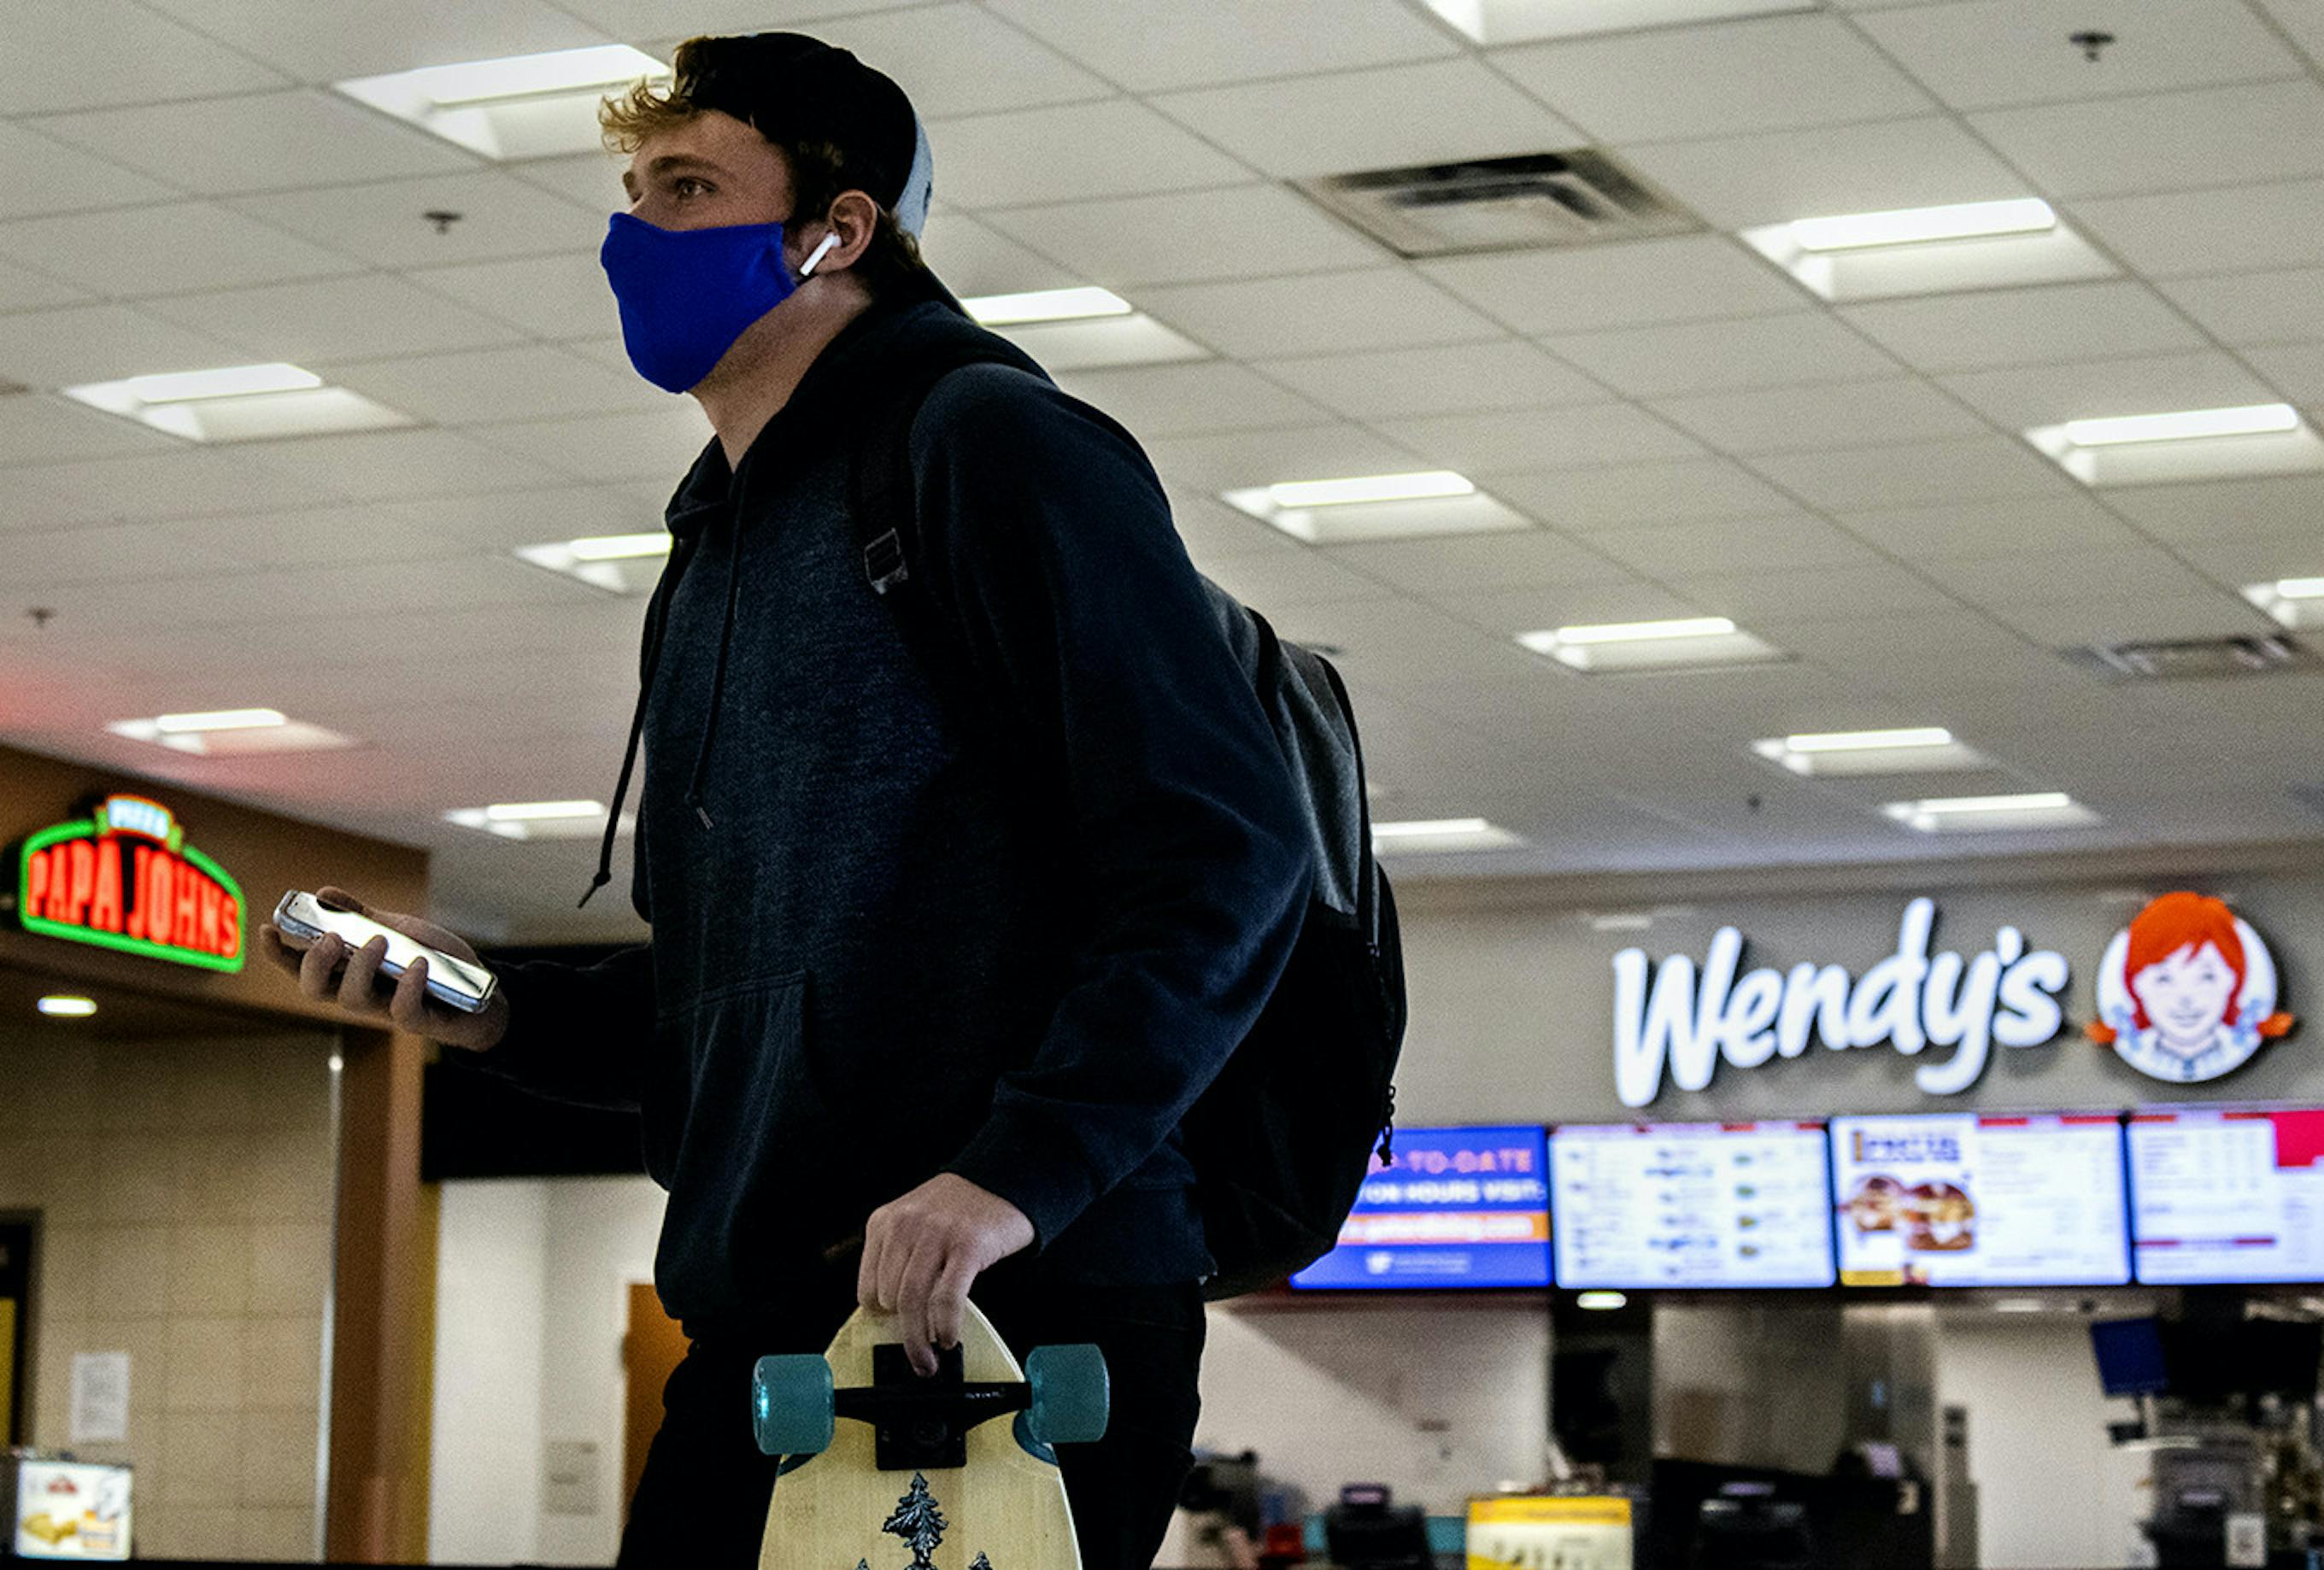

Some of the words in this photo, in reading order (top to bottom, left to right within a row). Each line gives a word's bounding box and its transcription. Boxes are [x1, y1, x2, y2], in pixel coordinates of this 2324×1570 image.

[26, 839, 124, 933] PAPA
[126, 845, 239, 958] JOHNS
[1613, 897, 2069, 1108] Wendy's
